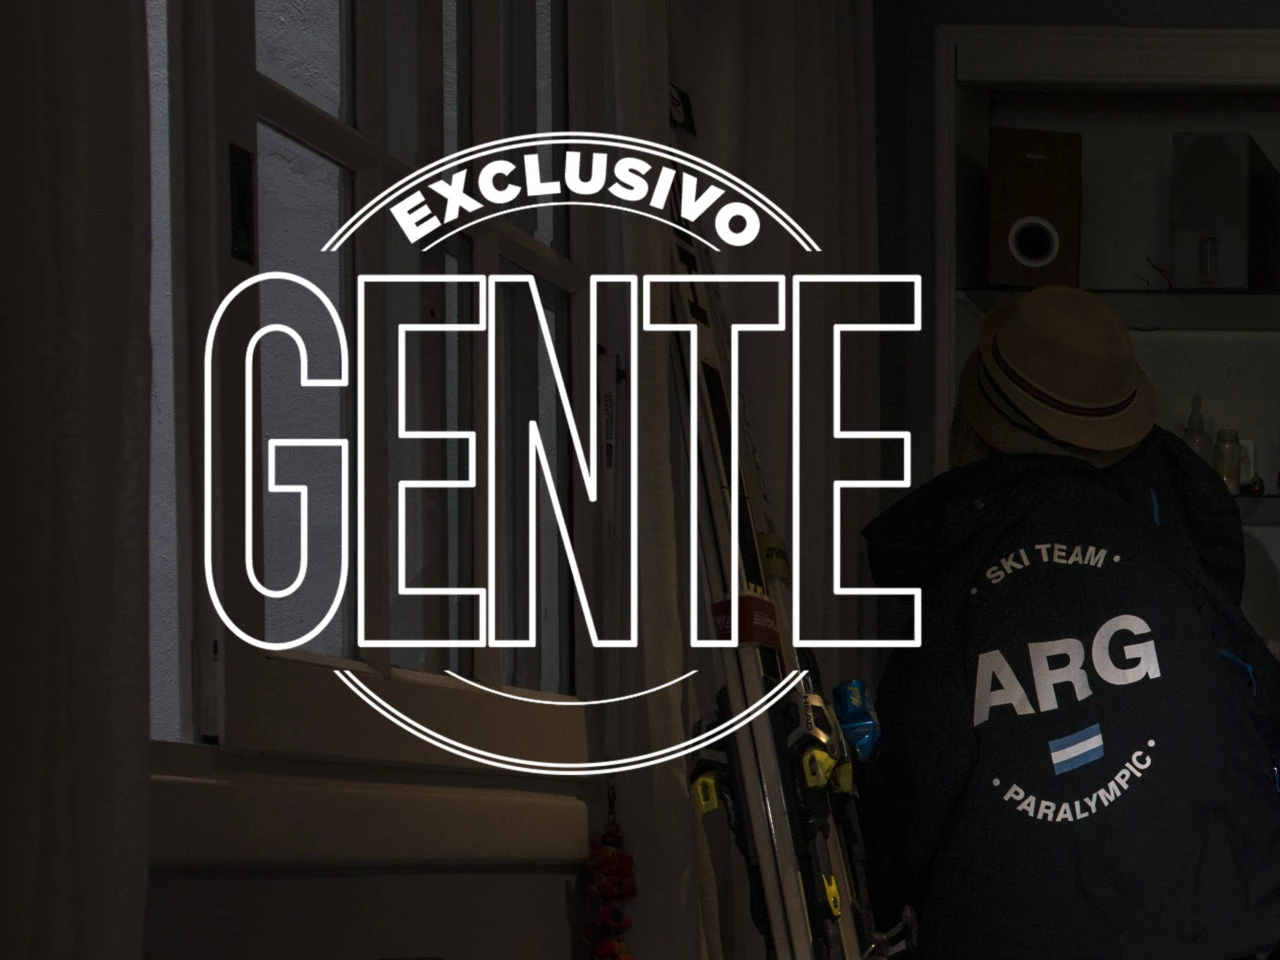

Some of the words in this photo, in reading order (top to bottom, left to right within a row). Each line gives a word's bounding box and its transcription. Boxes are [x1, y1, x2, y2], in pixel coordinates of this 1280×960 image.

[985, 548, 1030, 584] SKI
[1035, 543, 1107, 568] TEAM
[973, 614, 1161, 727] ARG
[1002, 750, 1153, 822] PARALYMPIC
